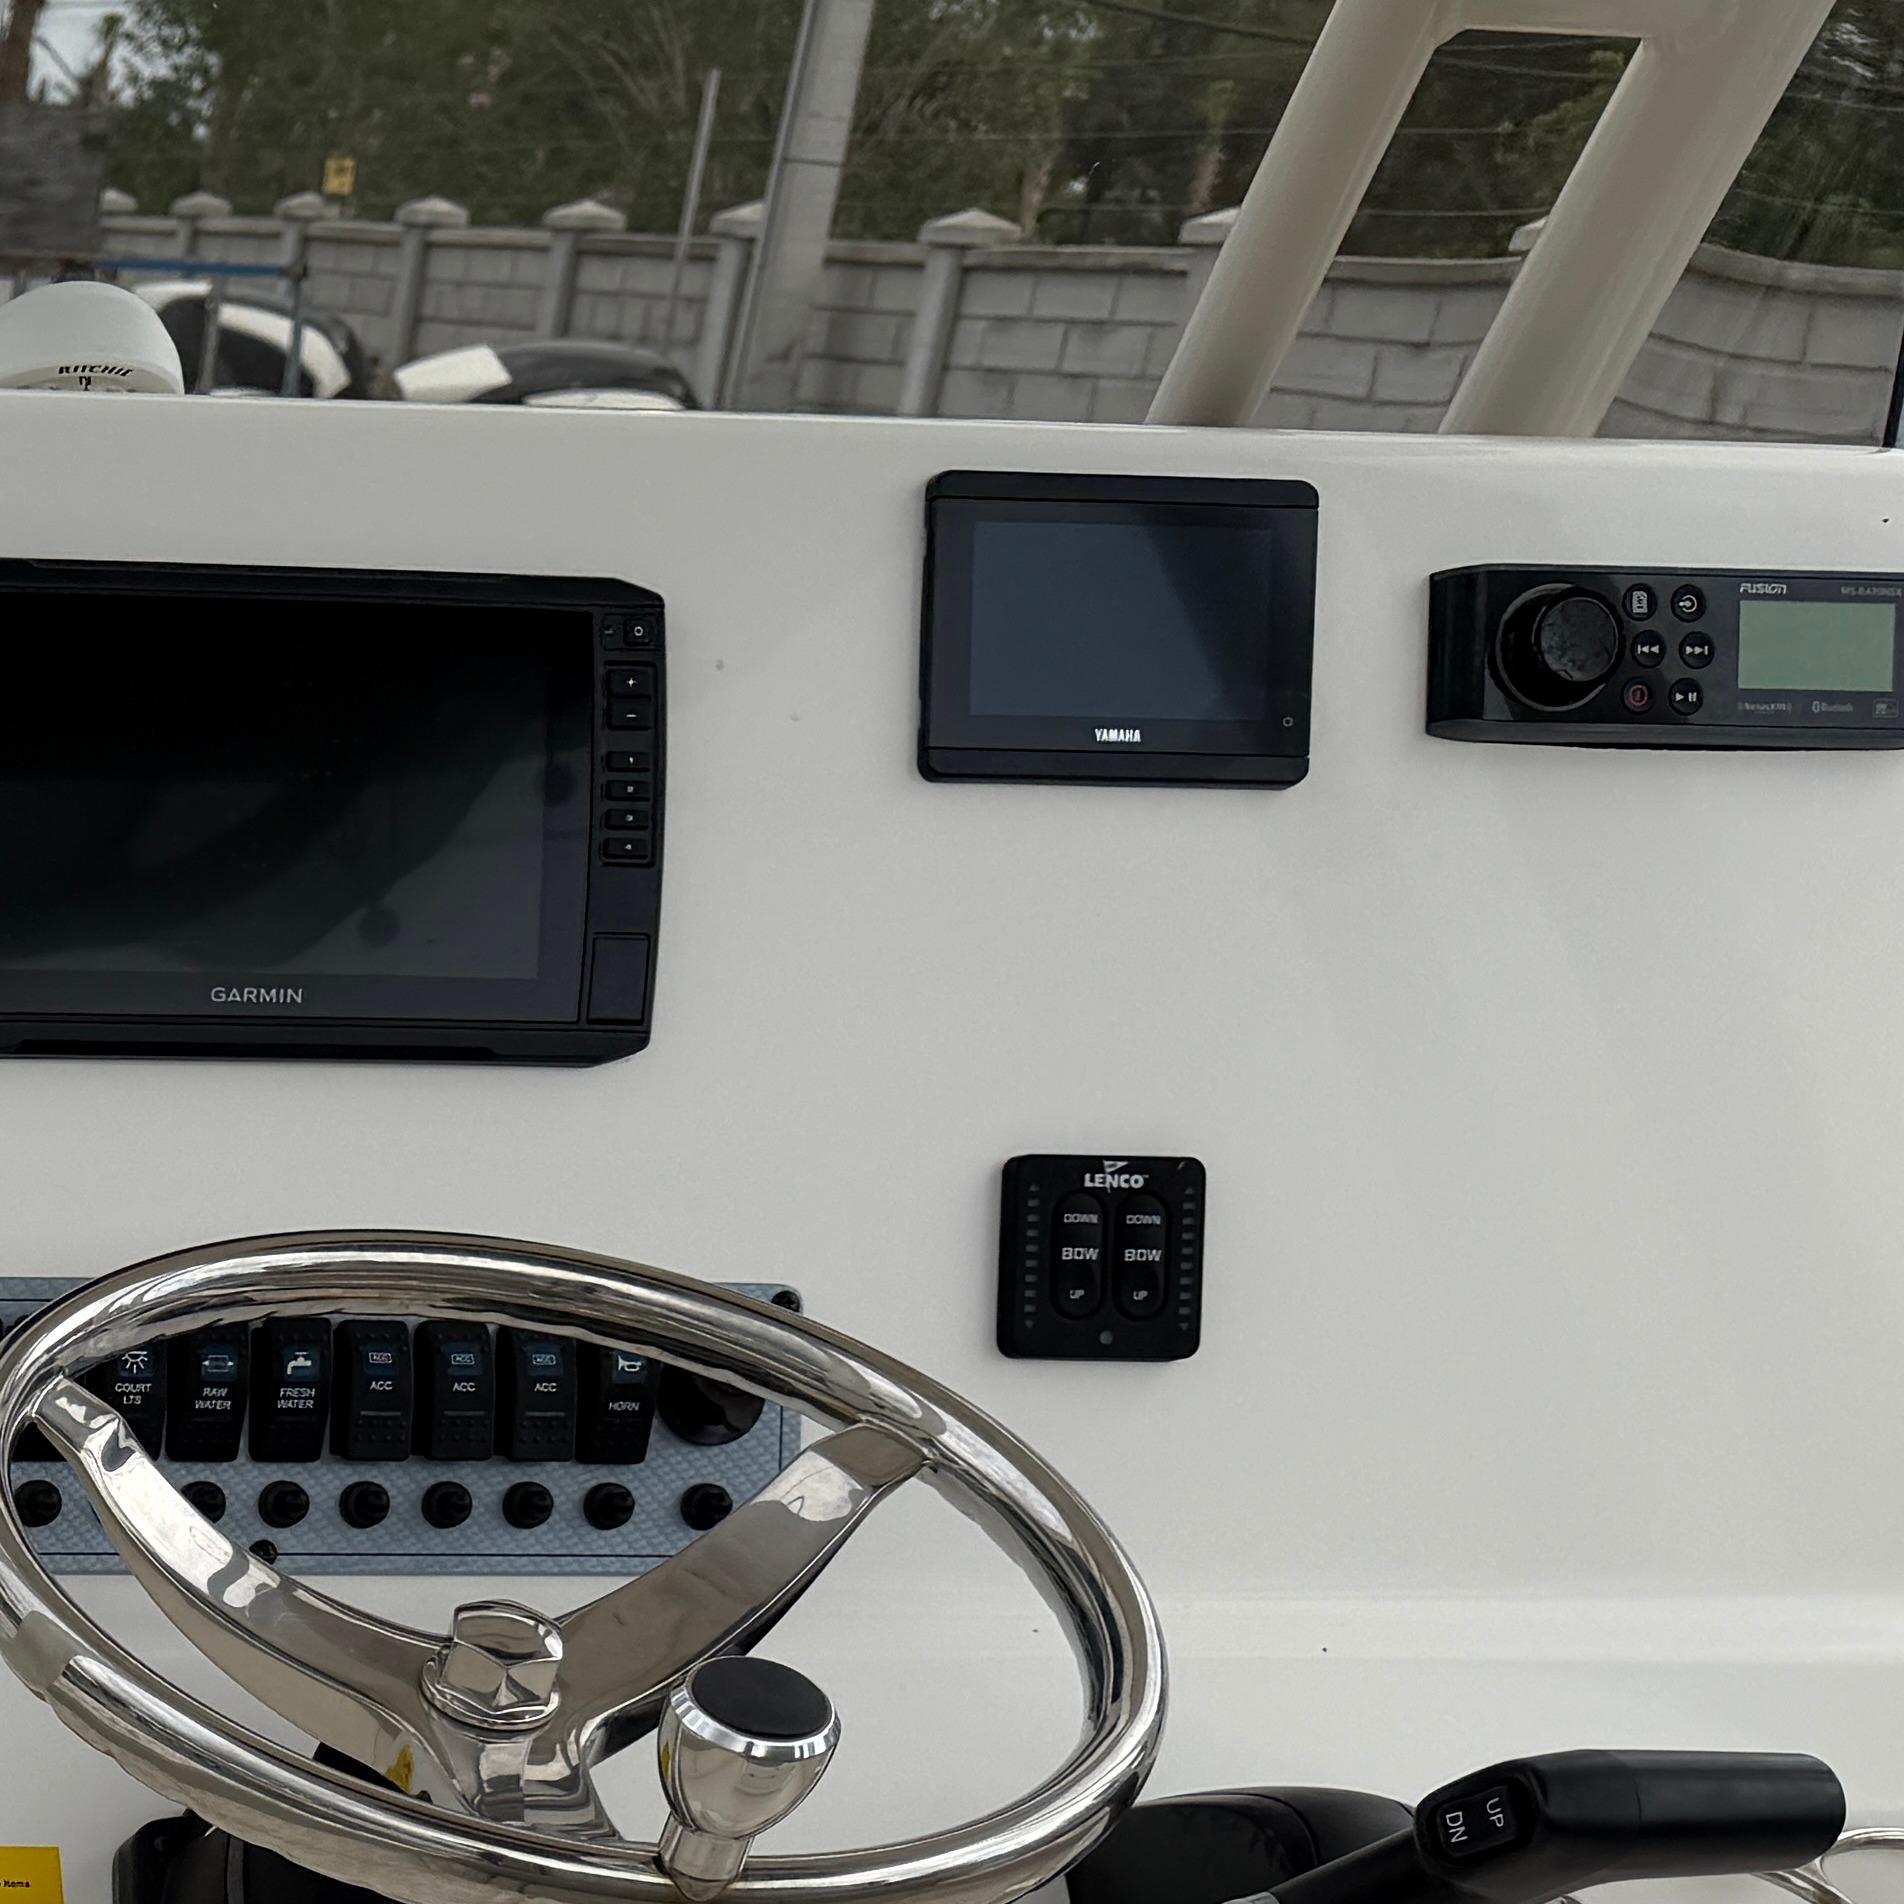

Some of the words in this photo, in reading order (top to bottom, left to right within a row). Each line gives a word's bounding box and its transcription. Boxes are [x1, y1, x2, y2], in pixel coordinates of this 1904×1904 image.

[58, 365, 134, 376] RITCHIE
[1095, 729, 1141, 742] YAMAHA
[211, 987, 302, 1003] GARMIN
[1084, 1173, 1144, 1188] LENCO
[1064, 1213, 1098, 1224] DOWN
[1126, 1214, 1161, 1225] DOWN
[1062, 1248, 1099, 1260] BOW
[1124, 1249, 1162, 1261] BOW
[1069, 1290, 1085, 1299] UP
[1133, 1291, 1148, 1300] UP
[115, 1383, 152, 1392] COURT
[370, 1381, 393, 1391] ACC
[452, 1382, 476, 1392] ACC
[534, 1382, 557, 1392] ACC
[202, 1388, 228, 1397] RAW
[280, 1388, 315, 1398] FRESH
[123, 1395, 142, 1404] LTS
[277, 1399, 314, 1409] WATER
[195, 1400, 231, 1410] WATER
[609, 1402, 640, 1411] HORN
[1486, 1797, 1504, 1827] UP
[1446, 1811, 1468, 1843] DN
